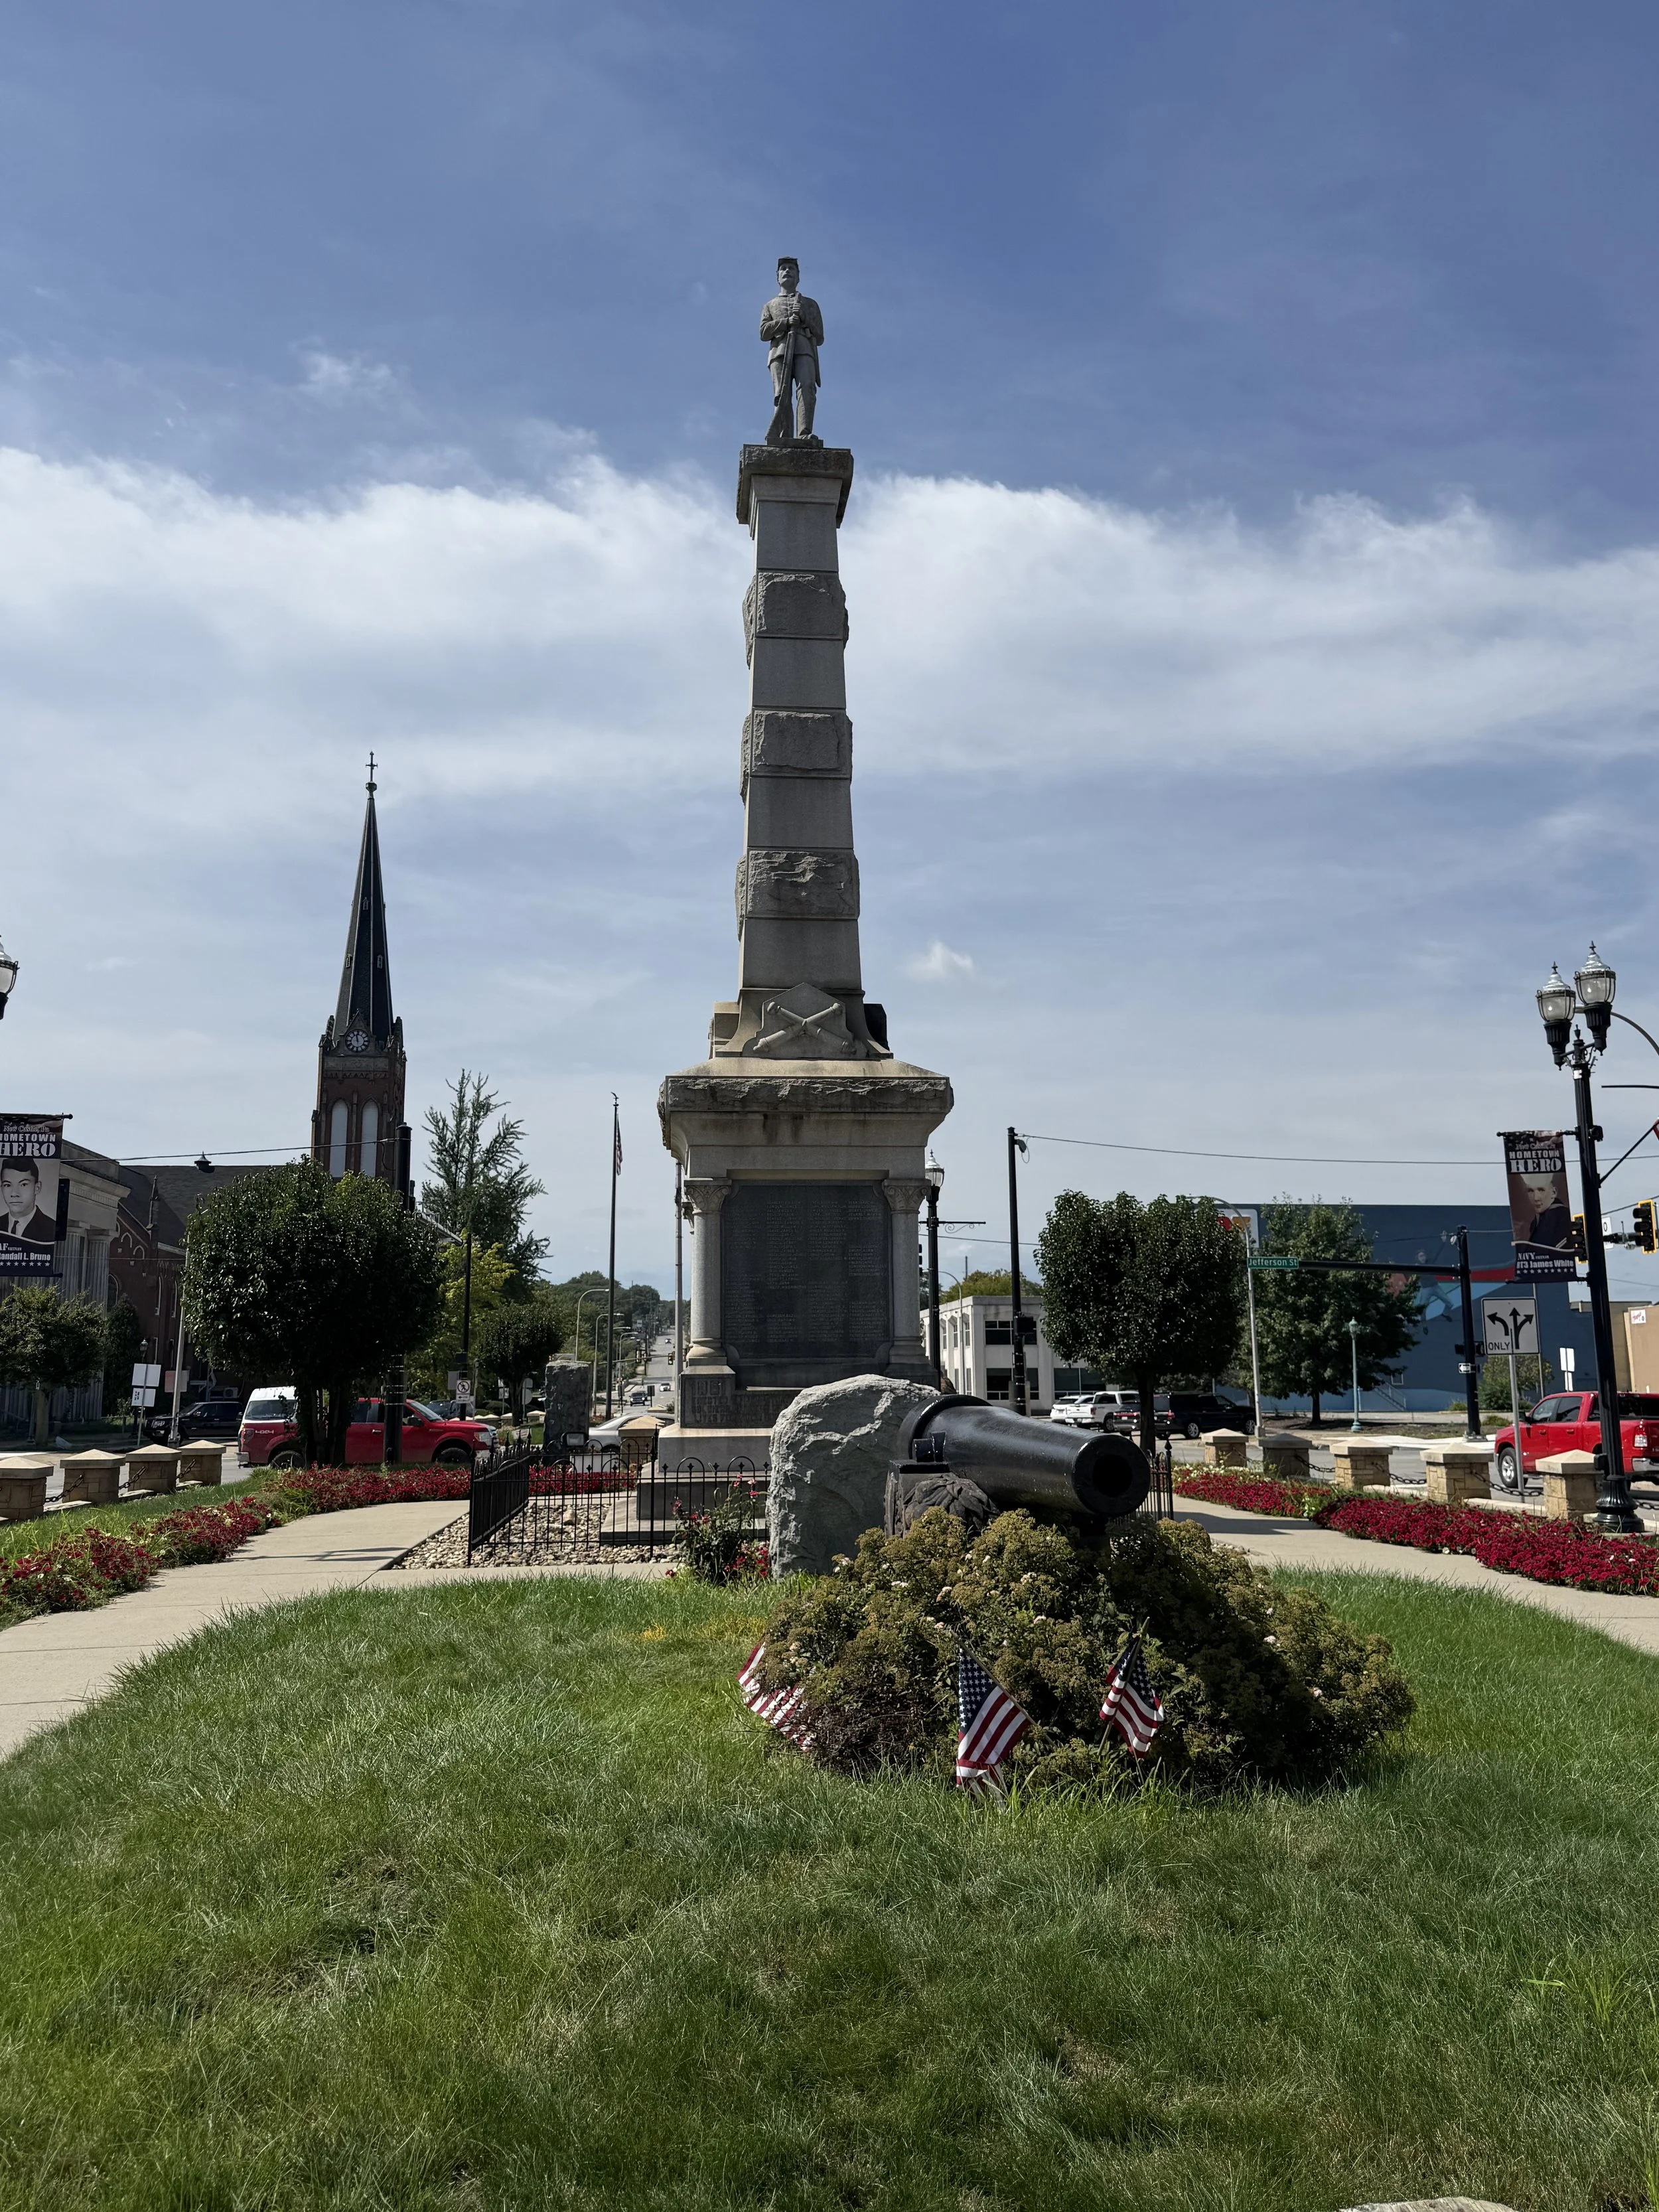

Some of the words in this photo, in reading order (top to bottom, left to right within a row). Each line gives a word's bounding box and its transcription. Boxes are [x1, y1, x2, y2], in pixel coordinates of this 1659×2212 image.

[1509, 1149, 1560, 1159] HOMETOWN
[1509, 1157, 1562, 1173] HERO
[1518, 1252, 1536, 1260] NAVY
[1488, 1341, 1510, 1351] ONLY
